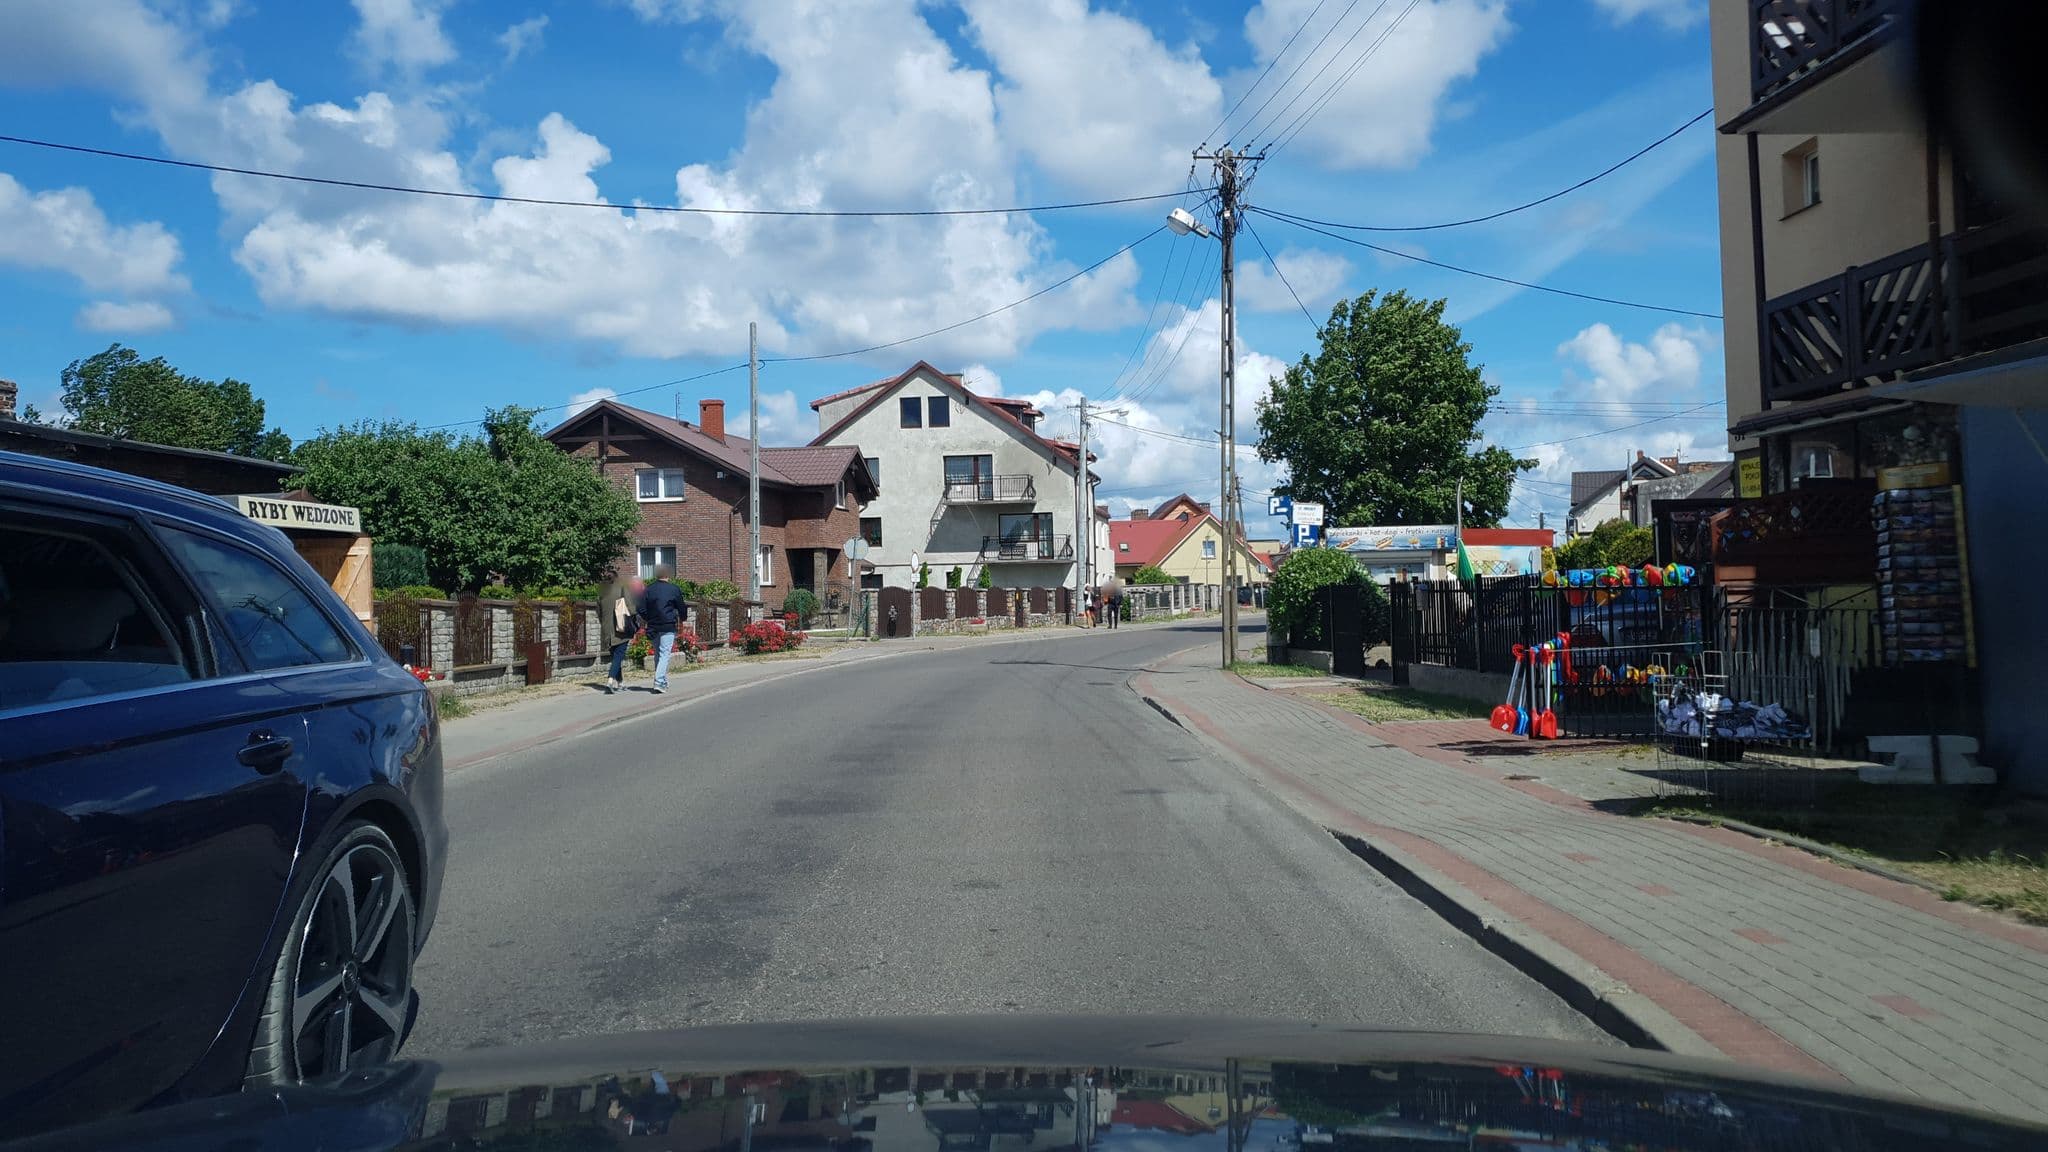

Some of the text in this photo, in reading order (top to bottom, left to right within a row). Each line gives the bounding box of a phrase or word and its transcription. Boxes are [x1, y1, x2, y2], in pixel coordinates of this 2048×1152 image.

[248, 500, 288, 520] RYBY
[1270, 497, 1280, 514] P
[1298, 524, 1310, 543] P
